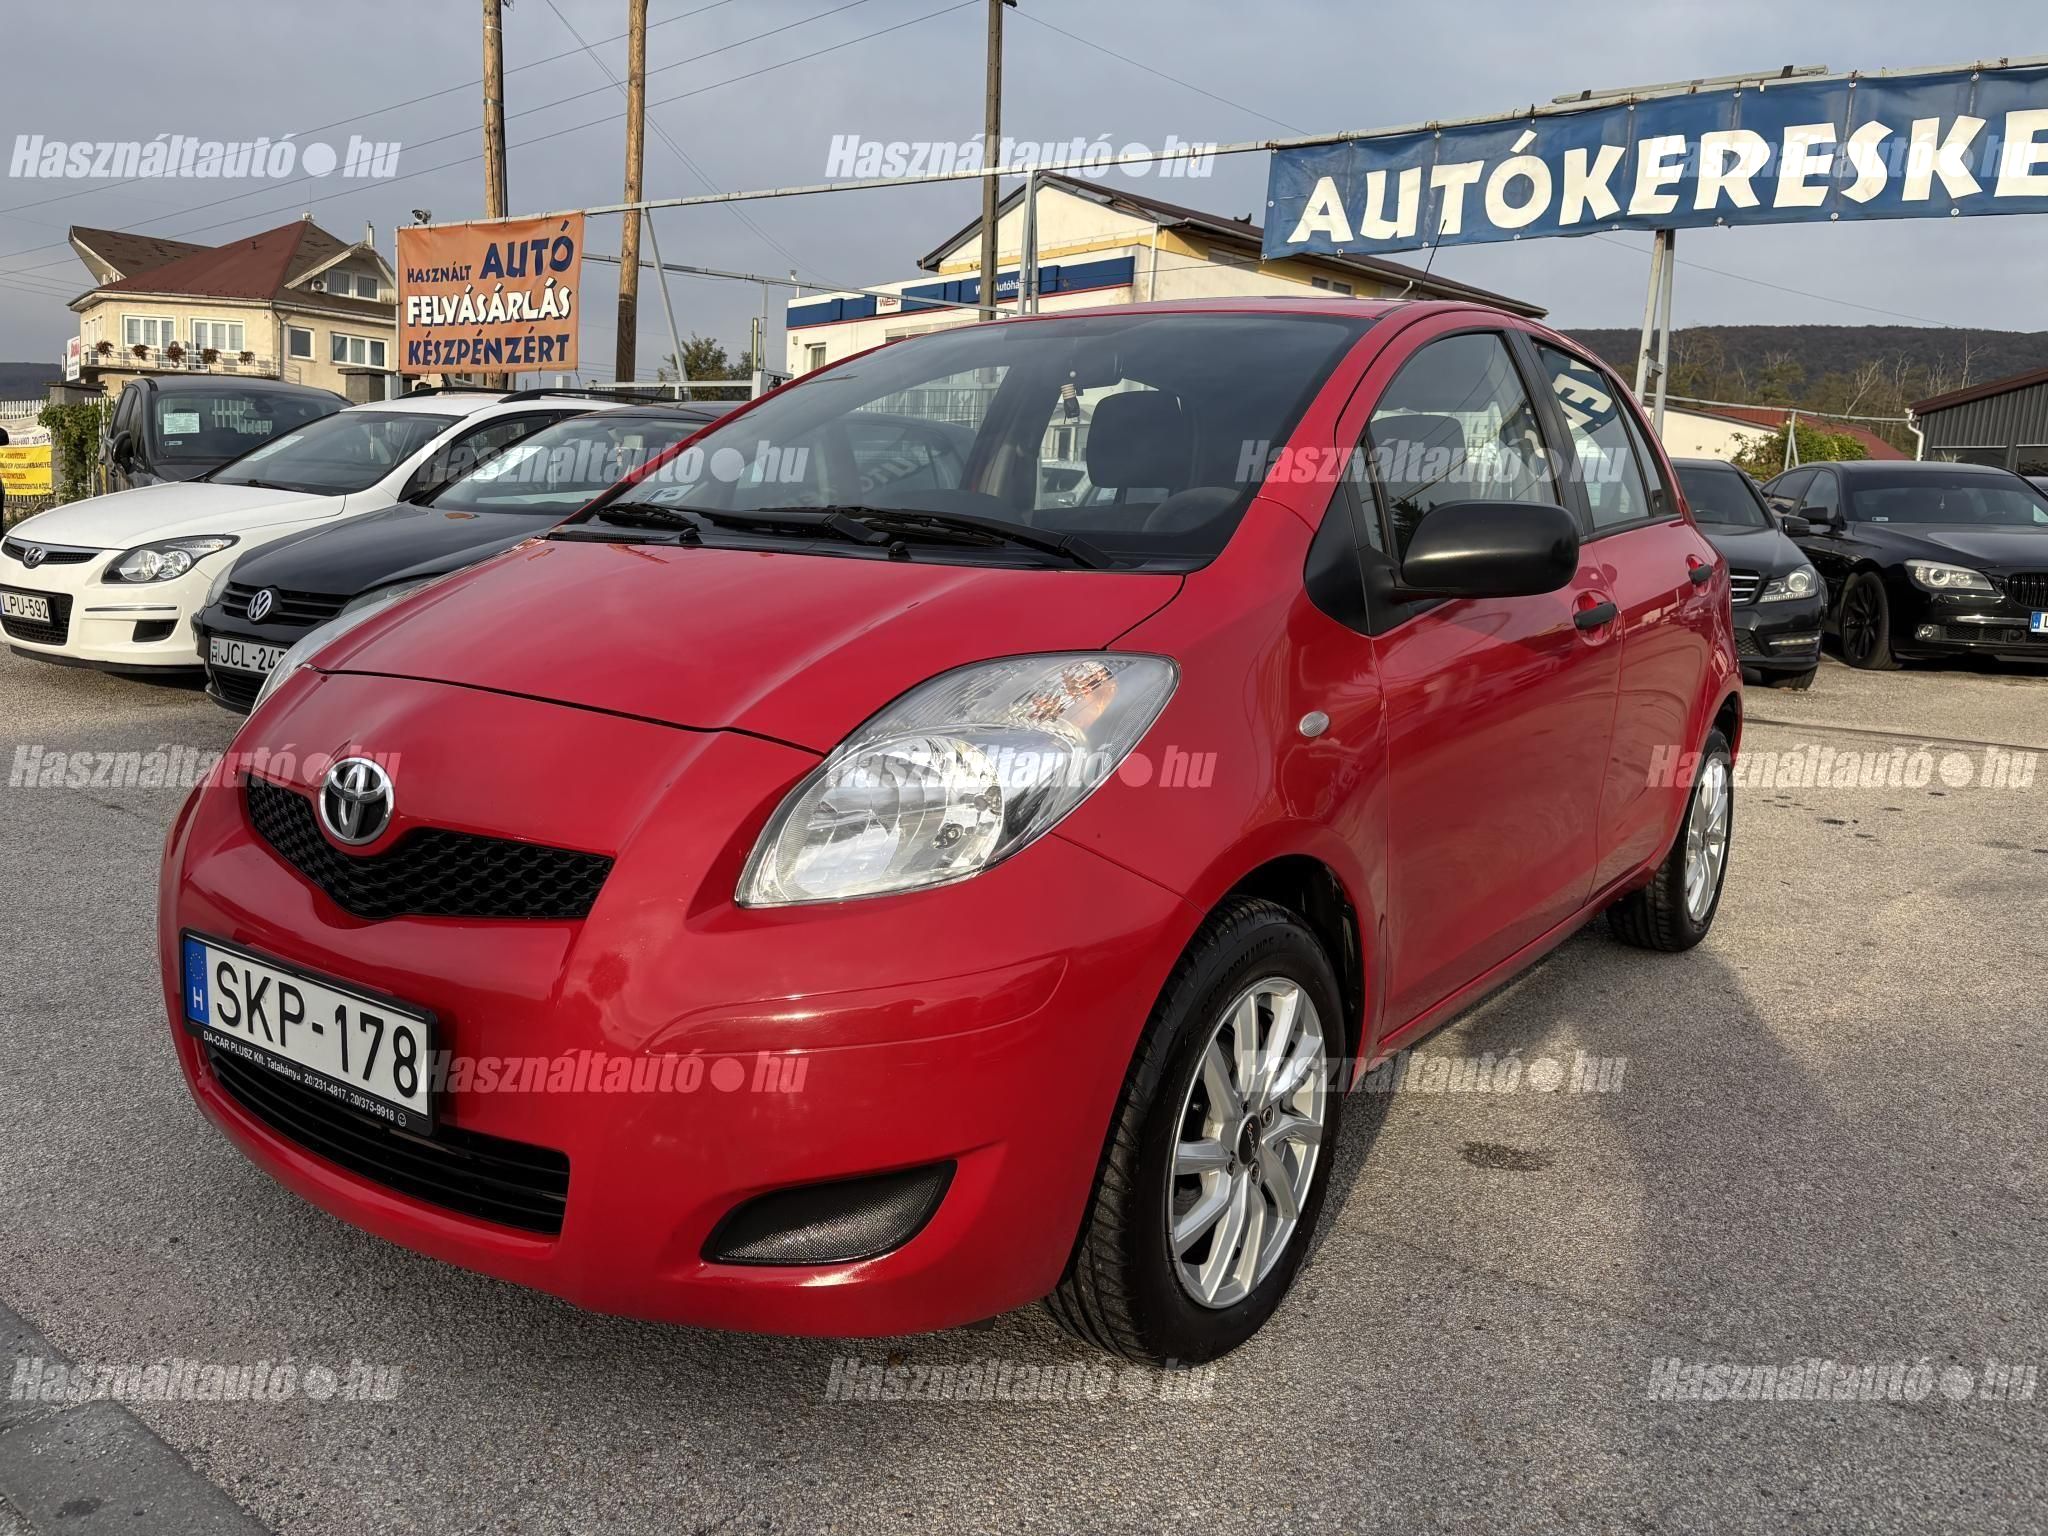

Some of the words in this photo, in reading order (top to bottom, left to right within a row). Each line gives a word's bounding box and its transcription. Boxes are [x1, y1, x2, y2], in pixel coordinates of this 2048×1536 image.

[1287, 109, 2048, 244] AUTÓKERESKE
[407, 261, 472, 283] HASZNÁLT
[479, 220, 574, 280] AUTÓ
[407, 277, 572, 327] FELVÁSÁRLÁS
[408, 326, 570, 366] KÉSZPÉNZÉRT
[2, 594, 49, 619] LPU-592
[193, 986, 204, 1011] H
[216, 960, 418, 1099] SKP-178
[203, 1030, 231, 1050] DA-CAR
[230, 1043, 253, 1062] PLUSZ
